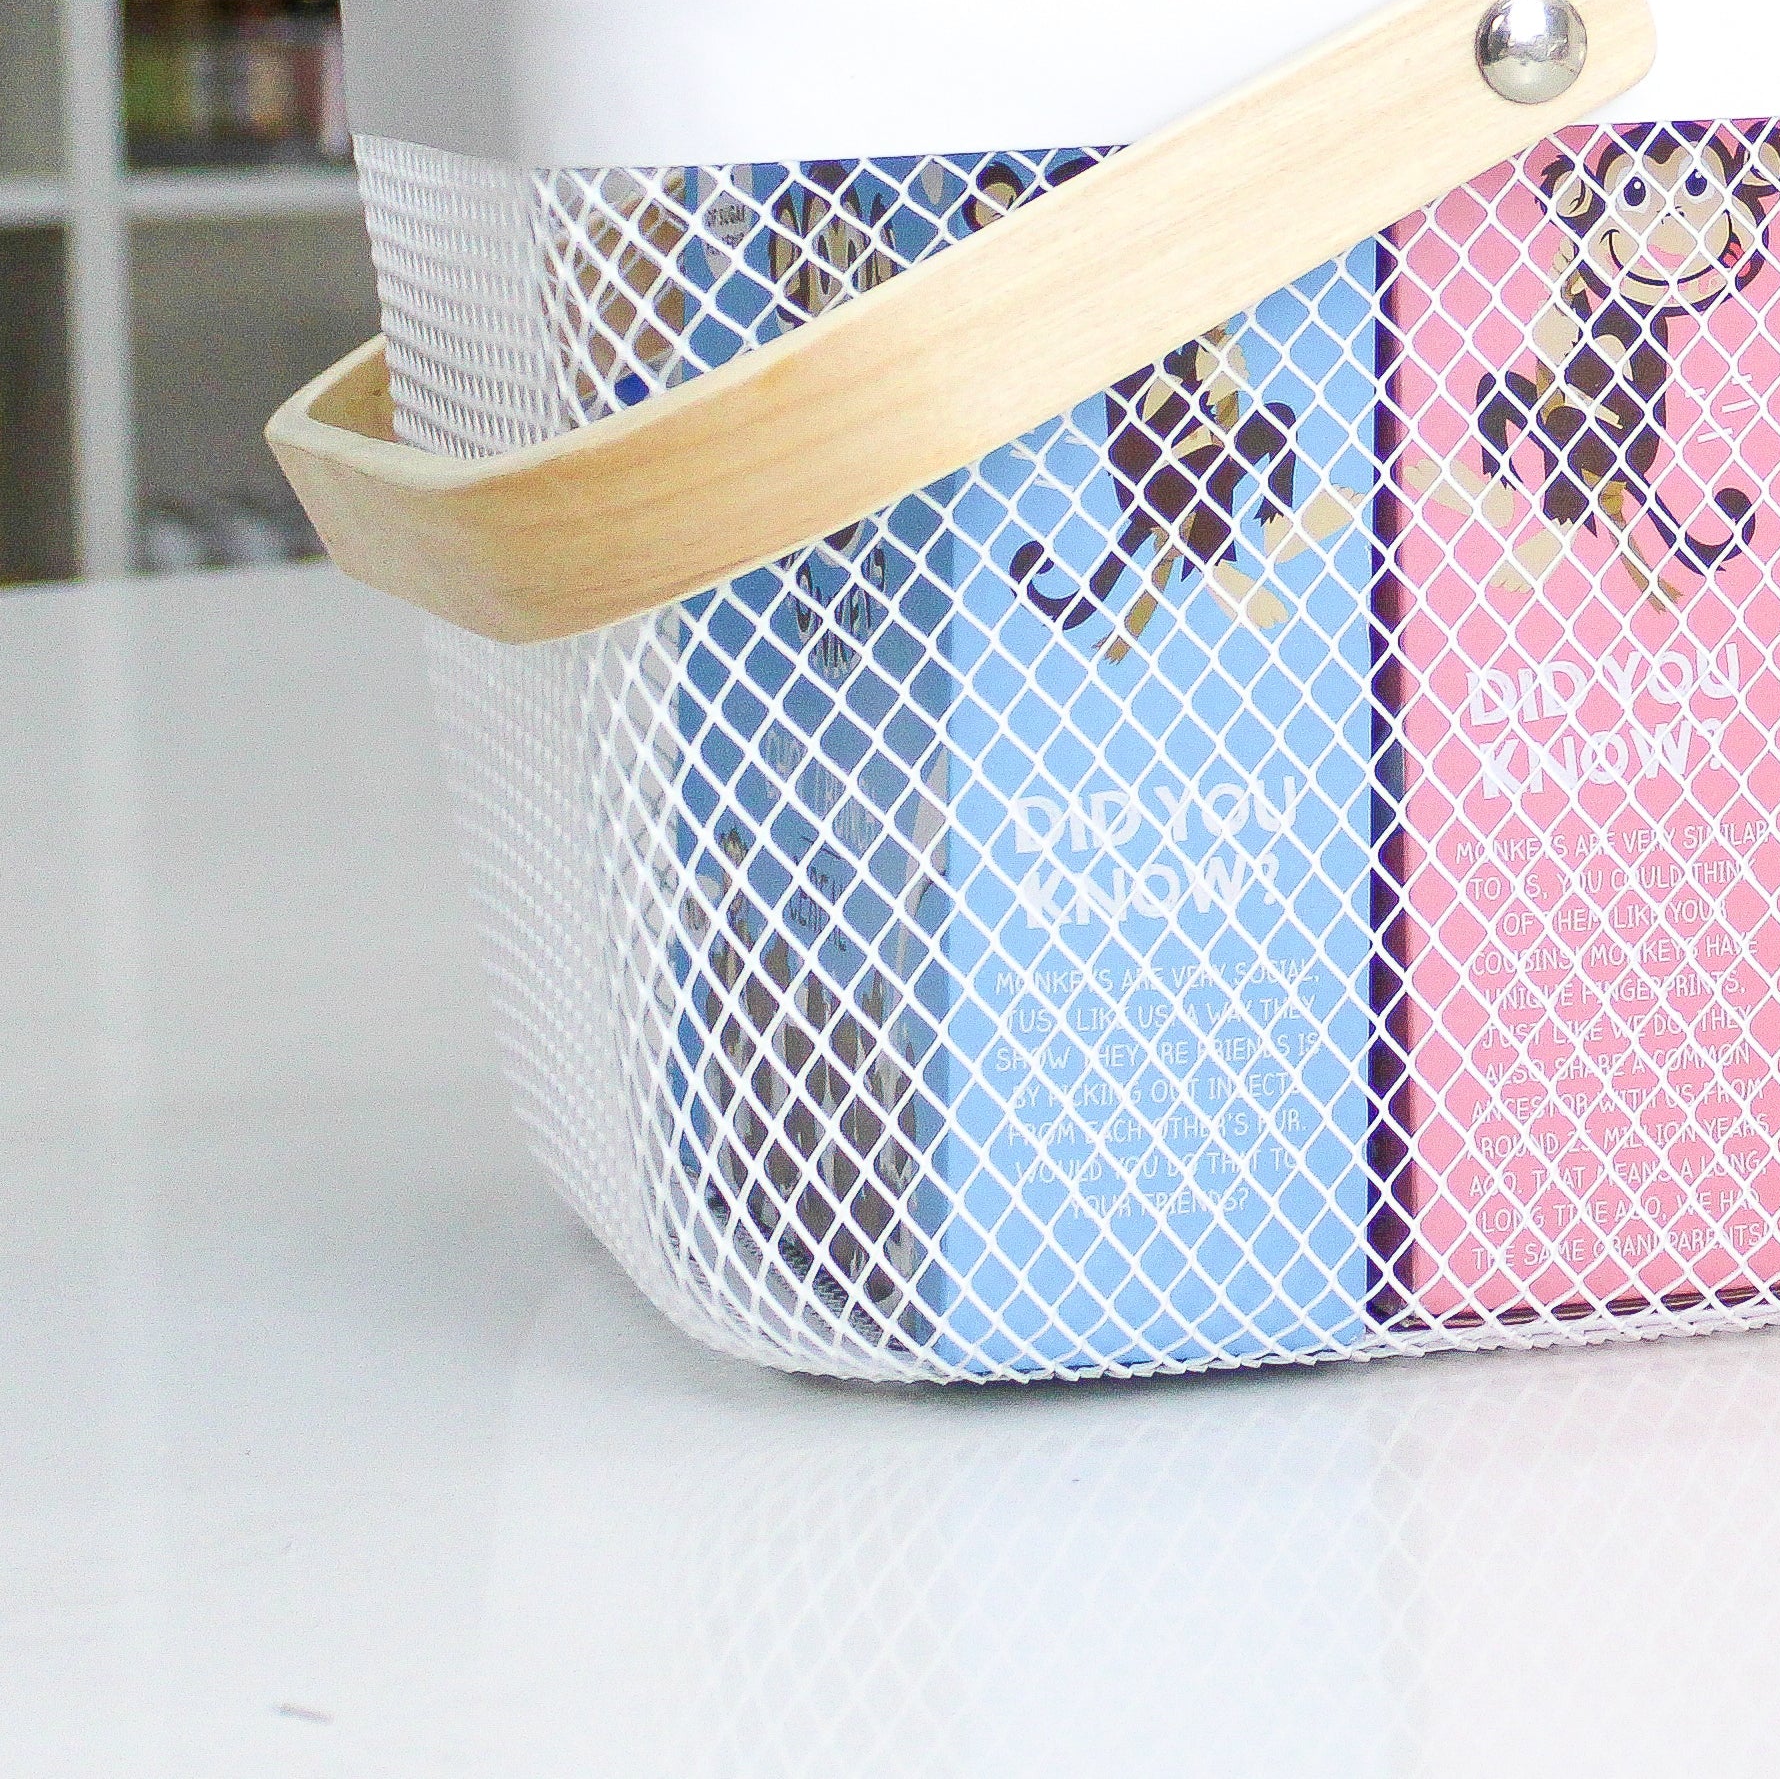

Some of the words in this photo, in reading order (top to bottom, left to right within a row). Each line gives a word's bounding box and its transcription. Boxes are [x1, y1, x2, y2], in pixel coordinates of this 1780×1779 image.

[1466, 660, 1588, 726] DID
[1603, 642, 1740, 704] YOU
[1479, 718, 1724, 800] KNOW?
[1016, 789, 1143, 853] DID
[1154, 775, 1297, 842] YOU
[1456, 834, 1569, 865] MONKES
[1682, 820, 1770, 850] SIILAR
[1022, 852, 1279, 929] KNOW?
[1469, 876, 1502, 901] TO
[1611, 863, 1682, 891] CULD
[1502, 912, 1536, 937] OF
[1590, 936, 1699, 967] MOKEYS
[995, 968, 1113, 995] MONKES
[1006, 1007, 1057, 1033] JUS
[1087, 1043, 1140, 1068] HEY
[1208, 1072, 1301, 1101] INECT
[1206, 1147, 1263, 1175] THT
[1531, 1165, 1587, 1192] TAT
